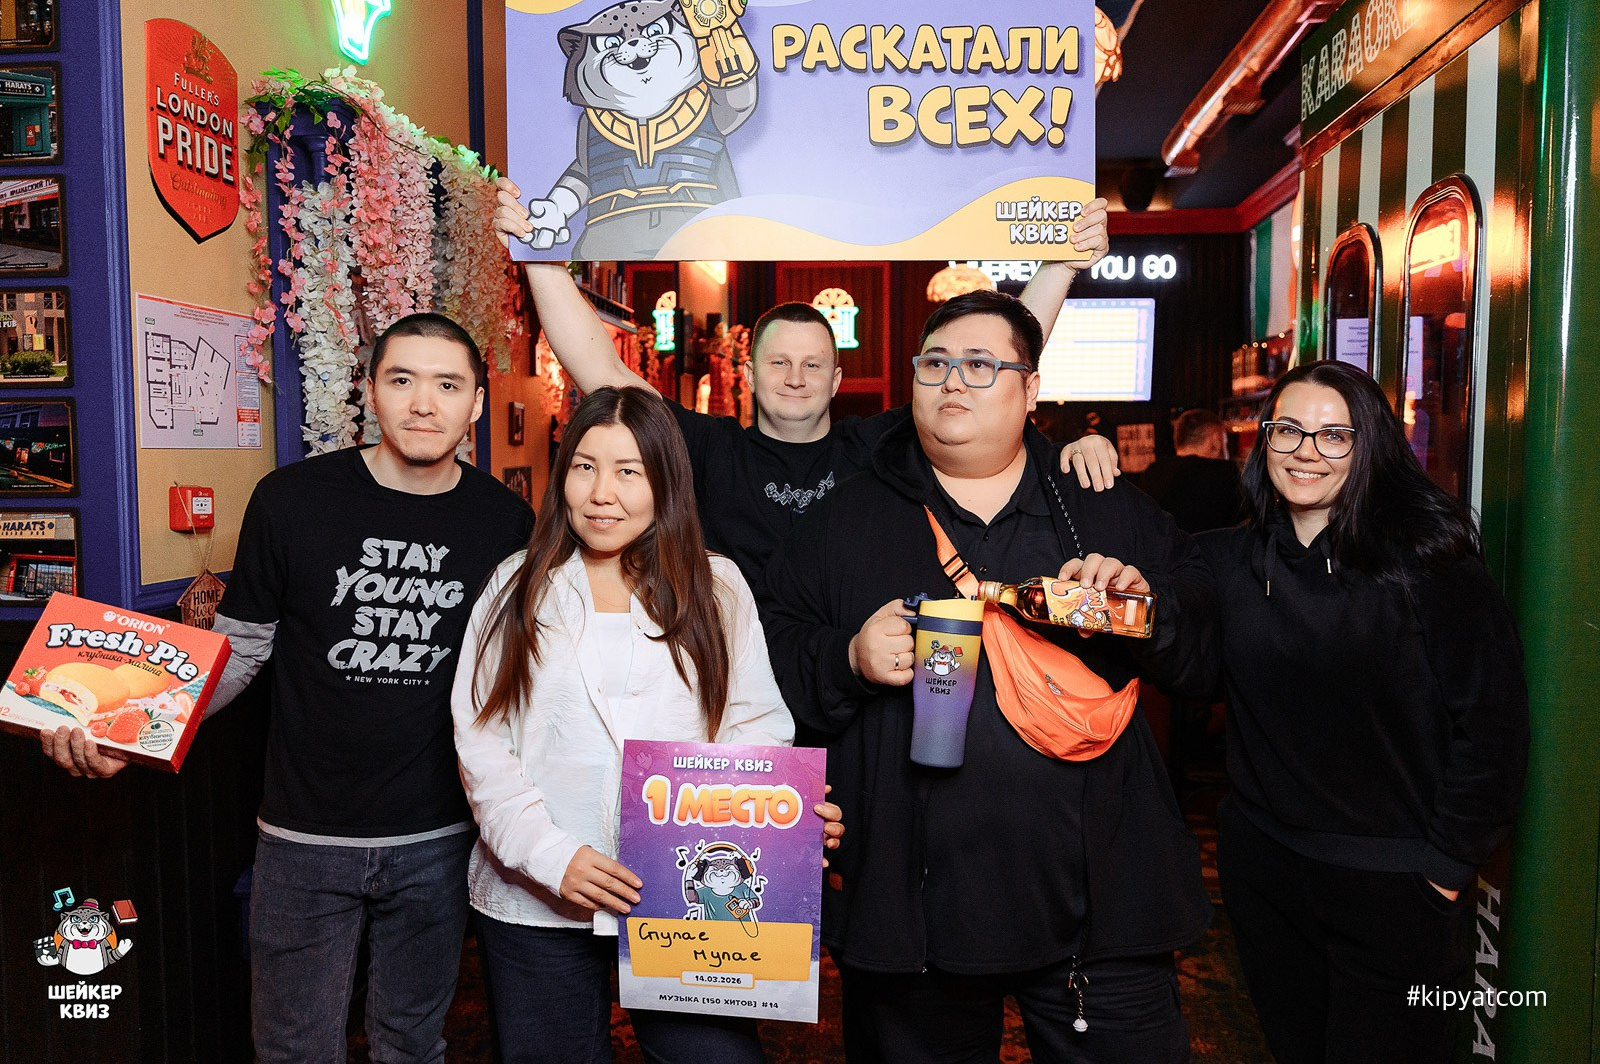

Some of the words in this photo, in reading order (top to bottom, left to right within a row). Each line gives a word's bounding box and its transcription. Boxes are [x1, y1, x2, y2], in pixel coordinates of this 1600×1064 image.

[772, 23, 1079, 74] РАСКАТАЛИ
[174, 72, 220, 107] FULLER'S
[156, 86, 233, 139] LONDON
[867, 84, 1074, 149] ВСЕХ!
[157, 114, 235, 184] PRIDE
[995, 196, 1083, 221] ШЕЙКЕР
[1009, 223, 1069, 244] КВИЗ
[1091, 255, 1136, 280] YOU
[1142, 253, 1177, 280] GO
[359, 537, 450, 573] STAY
[193, 589, 221, 605] HOME
[330, 565, 465, 609] YOUNG
[189, 604, 215, 617] swe
[194, 617, 215, 630] HOM
[351, 605, 442, 641] STAY
[327, 638, 452, 673] CRAZY
[354, 675, 373, 683] NEW
[377, 676, 399, 685] YORK
[925, 677, 957, 686] ШЕЙКЕР
[930, 686, 951, 695] КВИЗ
[673, 754, 730, 770] ШЕЙКЕР
[734, 759, 774, 773] КВИЗ
[644, 777, 669, 822] 1
[676, 786, 800, 826] МЕСТО
[694, 974, 742, 985] 14.03.2026
[659, 994, 700, 1004] МУЗЫКА
[702, 997, 721, 1005] [150
[723, 999, 757, 1008] ХИТОВ]
[761, 1001, 779, 1009] #14
